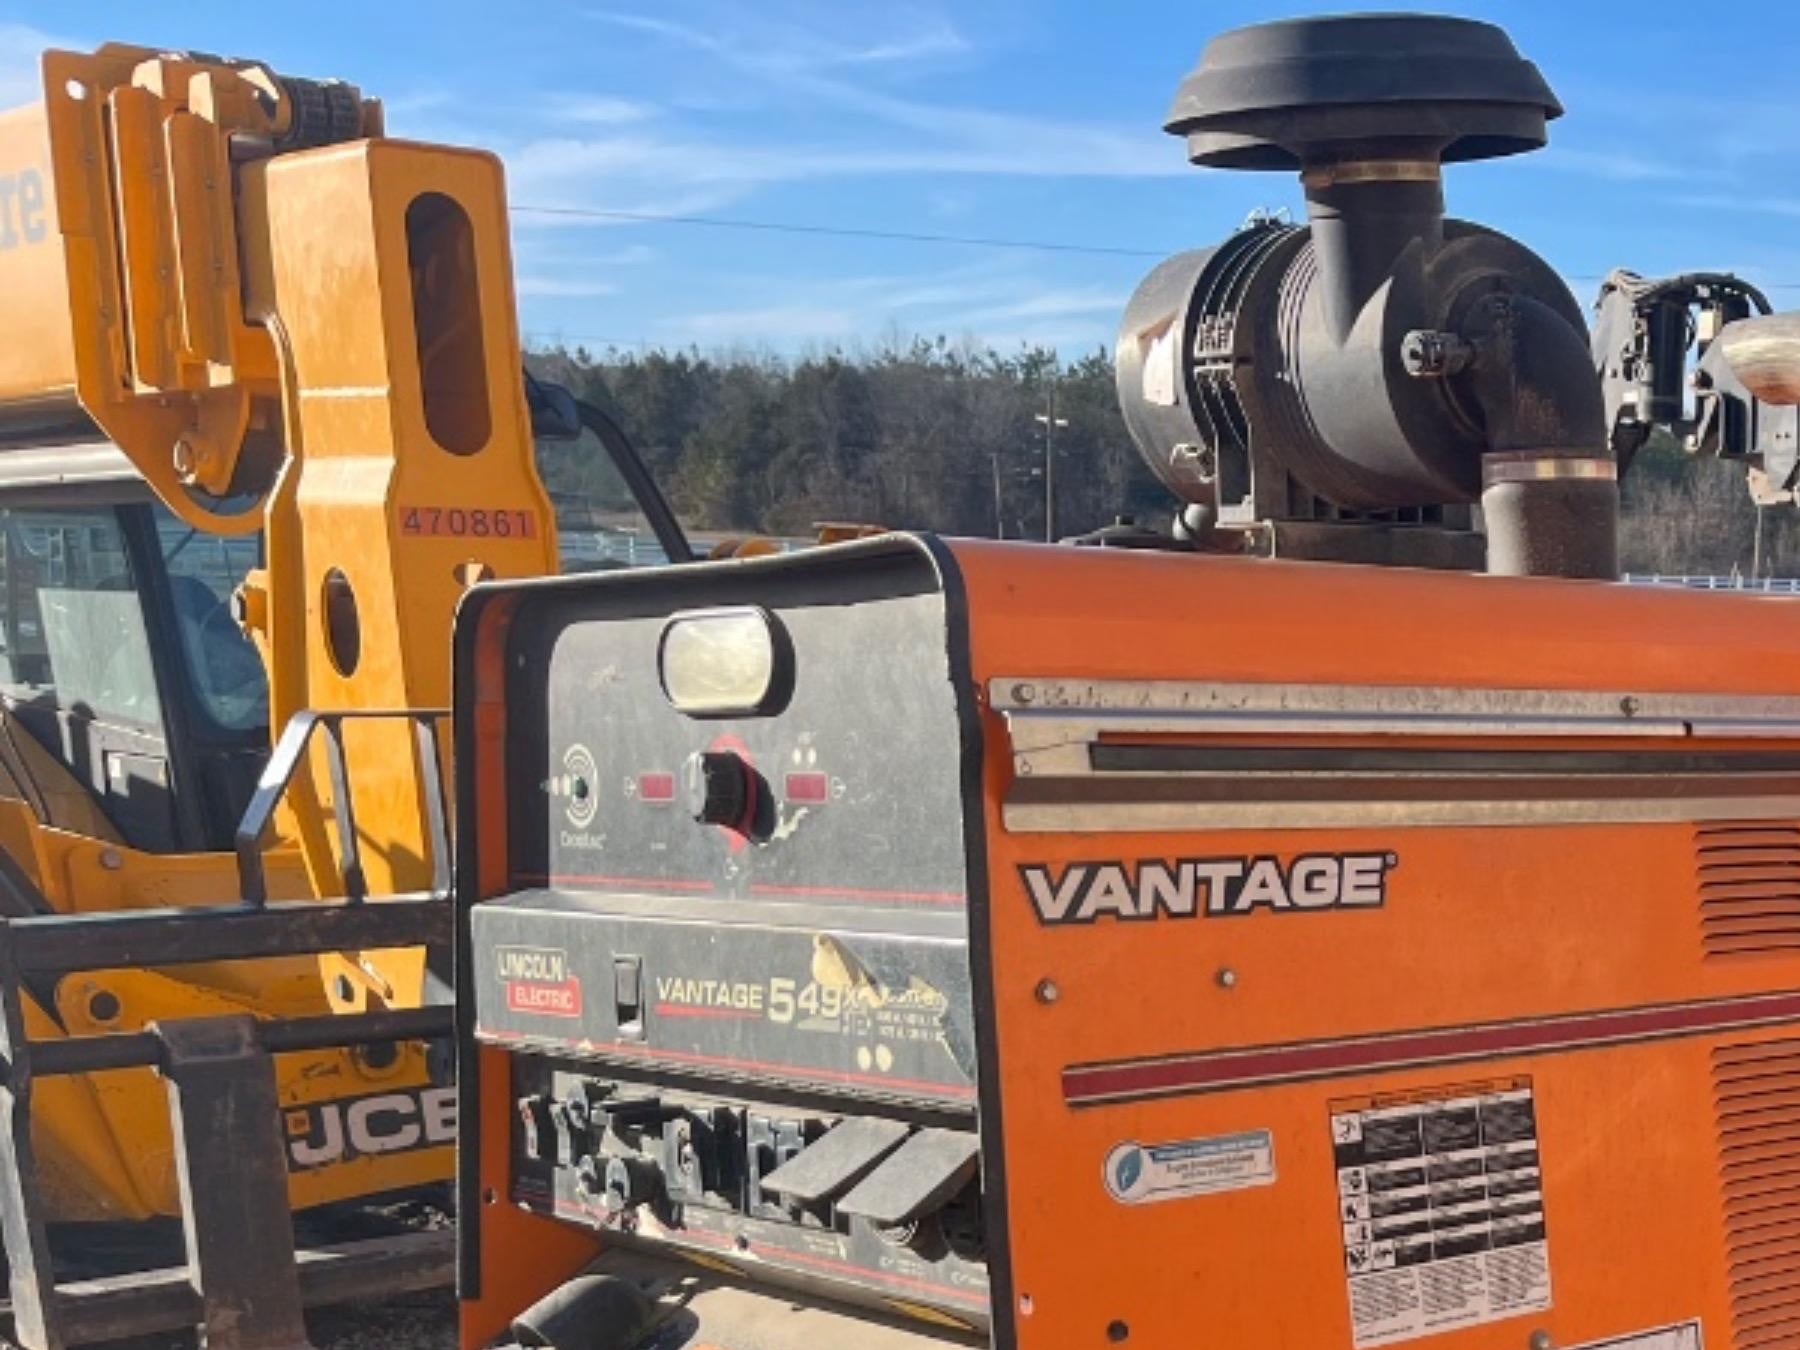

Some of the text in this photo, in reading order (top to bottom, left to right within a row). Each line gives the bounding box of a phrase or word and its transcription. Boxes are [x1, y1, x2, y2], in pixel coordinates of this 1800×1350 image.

[404, 507, 530, 537] 470861
[1018, 852, 1392, 925] VANTAGE
[499, 953, 565, 982] LINCOLN
[514, 984, 575, 1010] ELECTRIC
[656, 975, 764, 1009] VANTAGE
